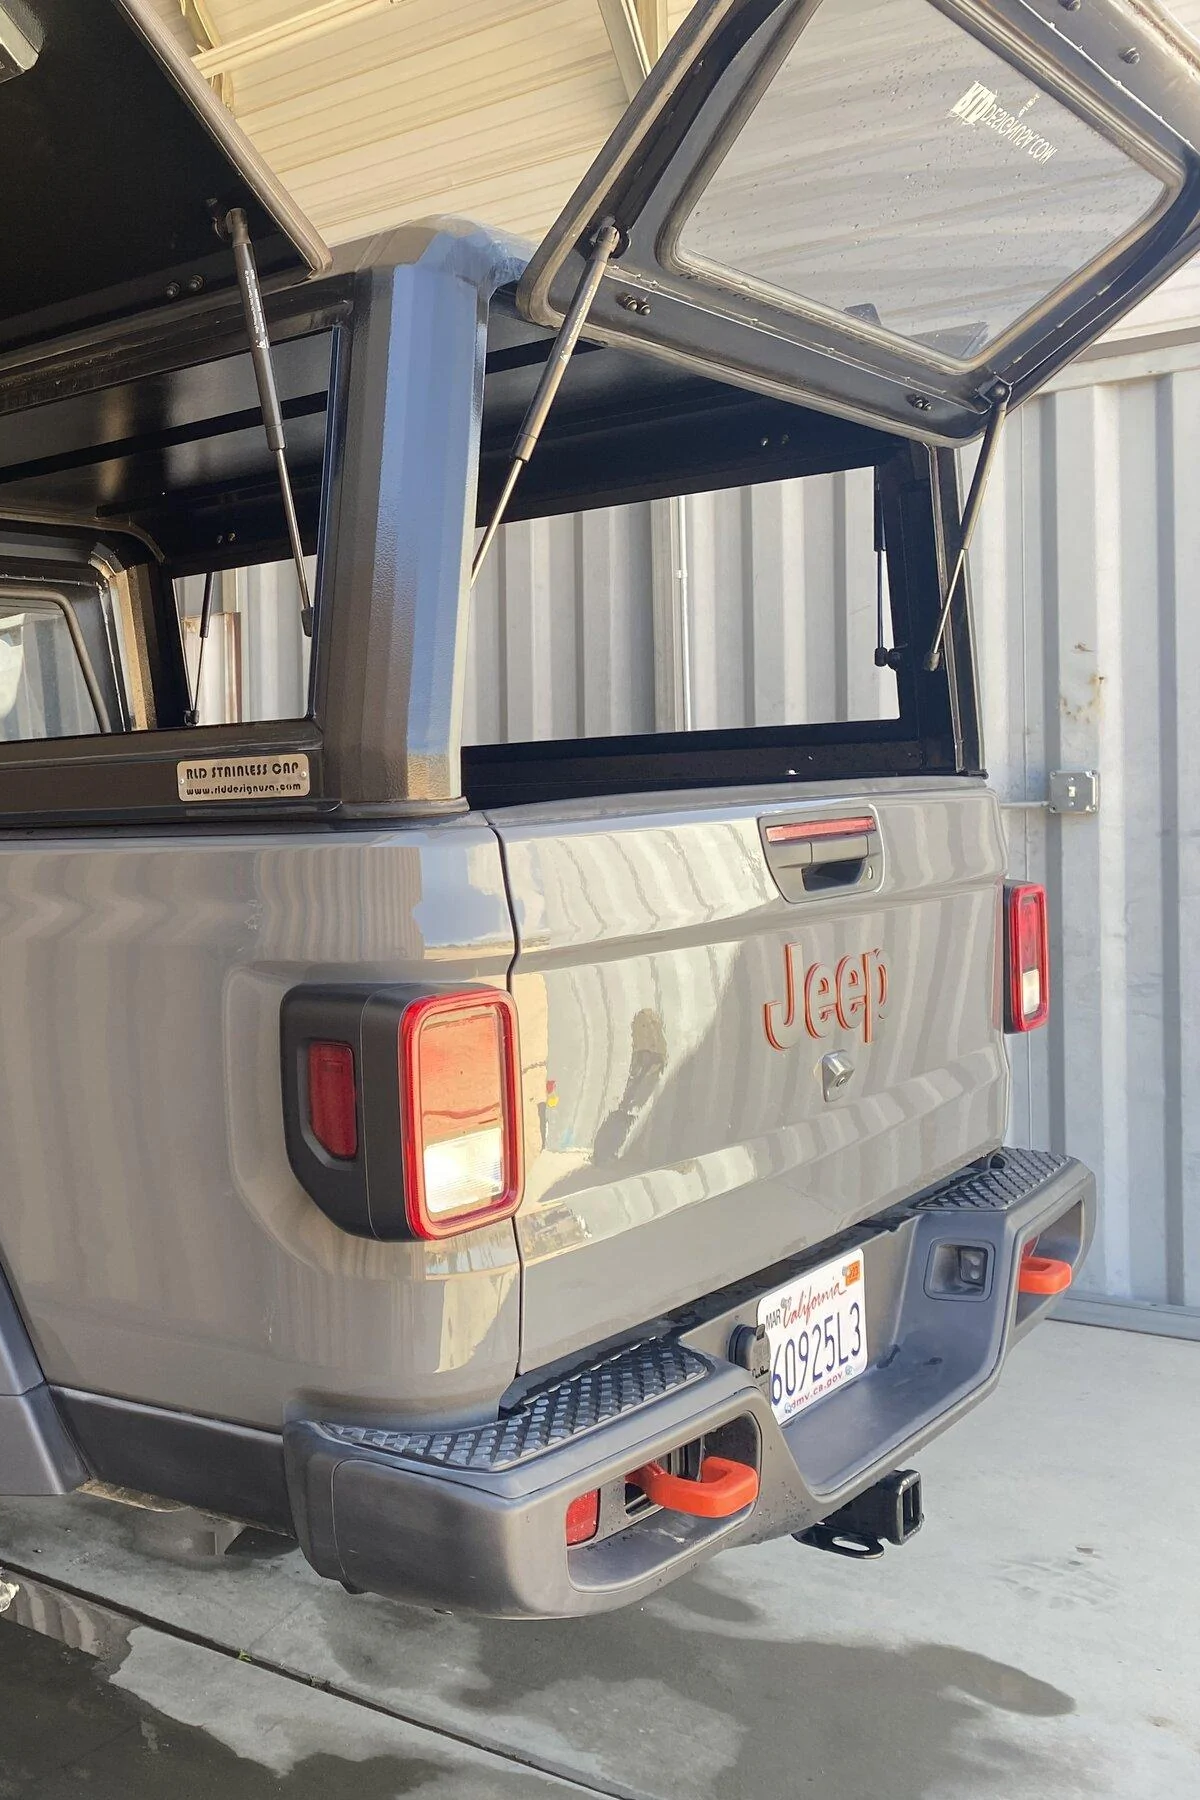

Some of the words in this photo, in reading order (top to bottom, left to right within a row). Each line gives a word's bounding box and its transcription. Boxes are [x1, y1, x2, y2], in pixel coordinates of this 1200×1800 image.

[186, 768, 208, 780] RLD
[211, 763, 267, 778] STAINLESS
[271, 762, 299, 775] CAP
[763, 941, 891, 1051] Jeep
[765, 1308, 781, 1331] MAR
[782, 1276, 847, 1330] California
[771, 1301, 861, 1406] 60925L3
[790, 1370, 844, 1411] dmv.ca.gov
